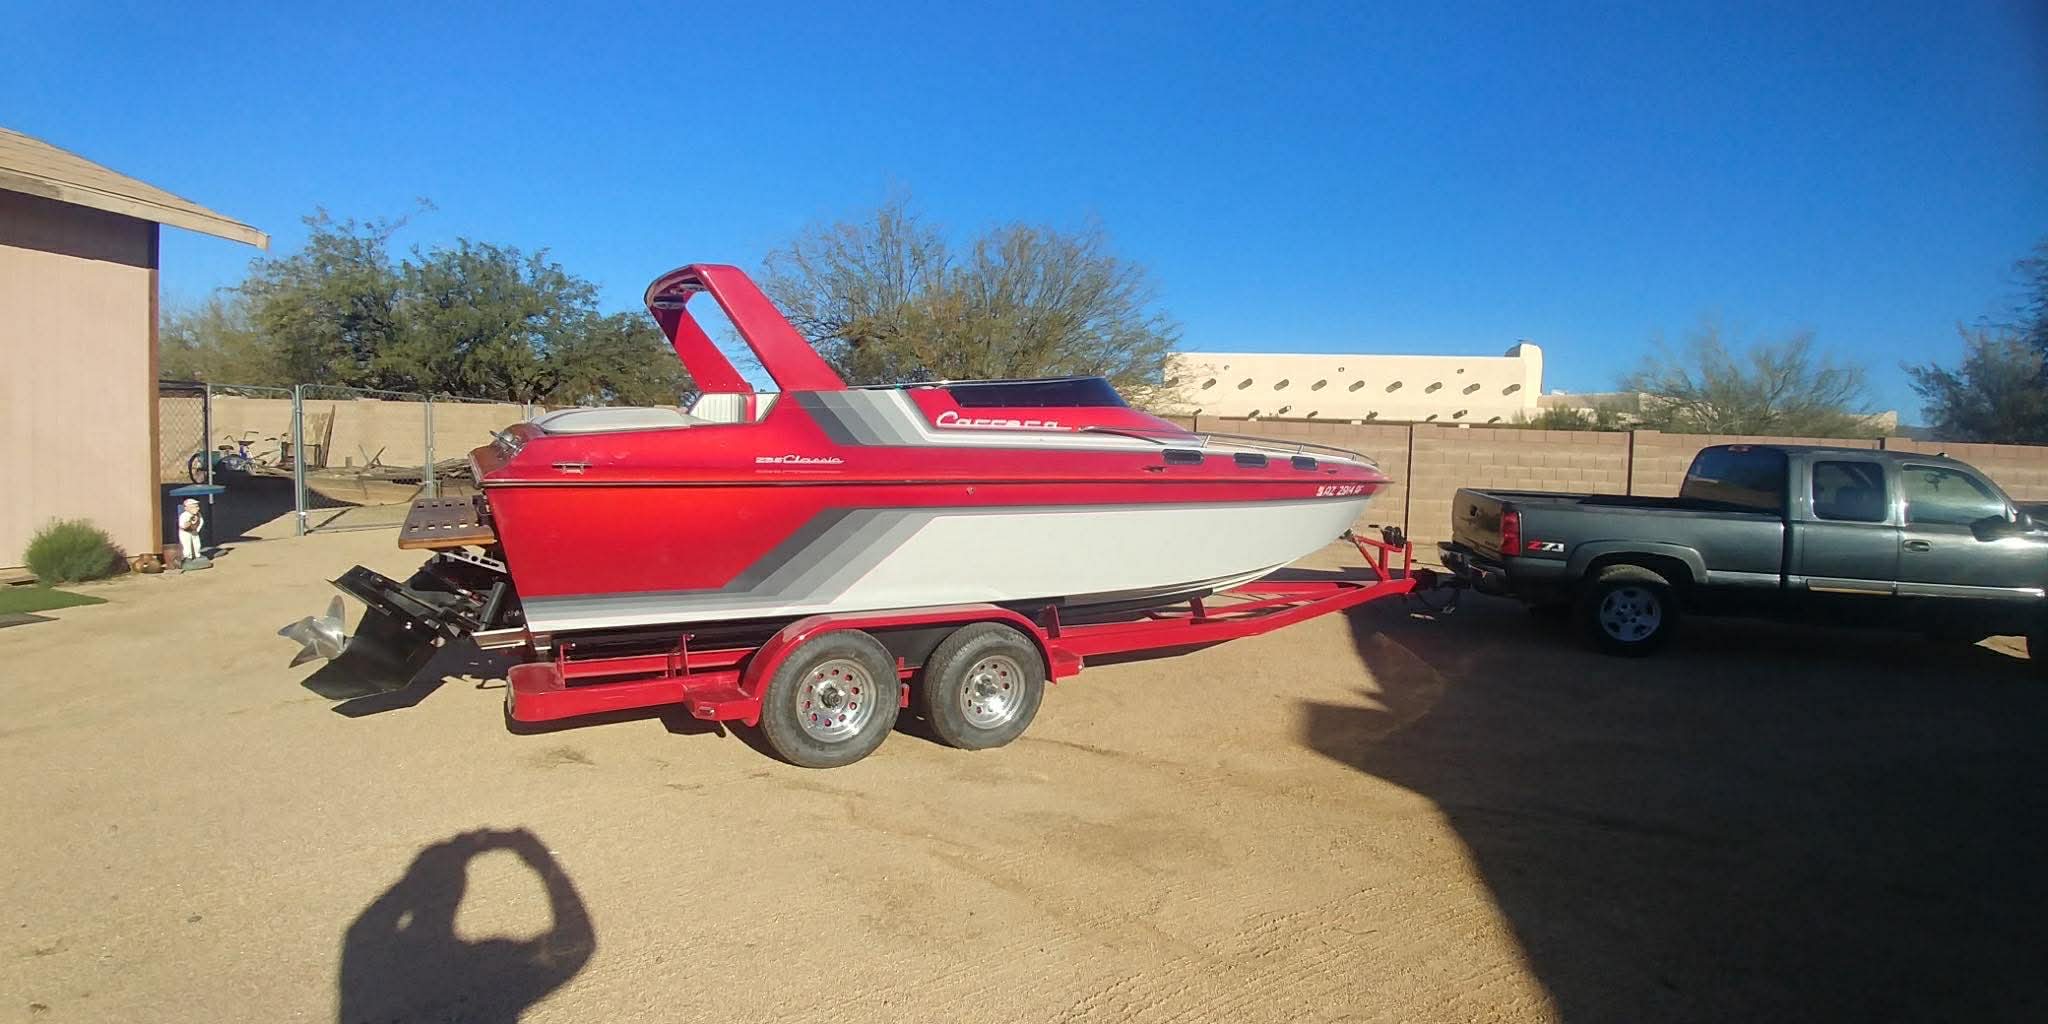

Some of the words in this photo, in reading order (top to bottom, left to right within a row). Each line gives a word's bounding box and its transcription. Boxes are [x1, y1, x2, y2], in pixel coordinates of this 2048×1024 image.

[936, 410, 1072, 430] Carrera
[782, 454, 844, 465] Classic
[1528, 541, 1565, 552] Z71
